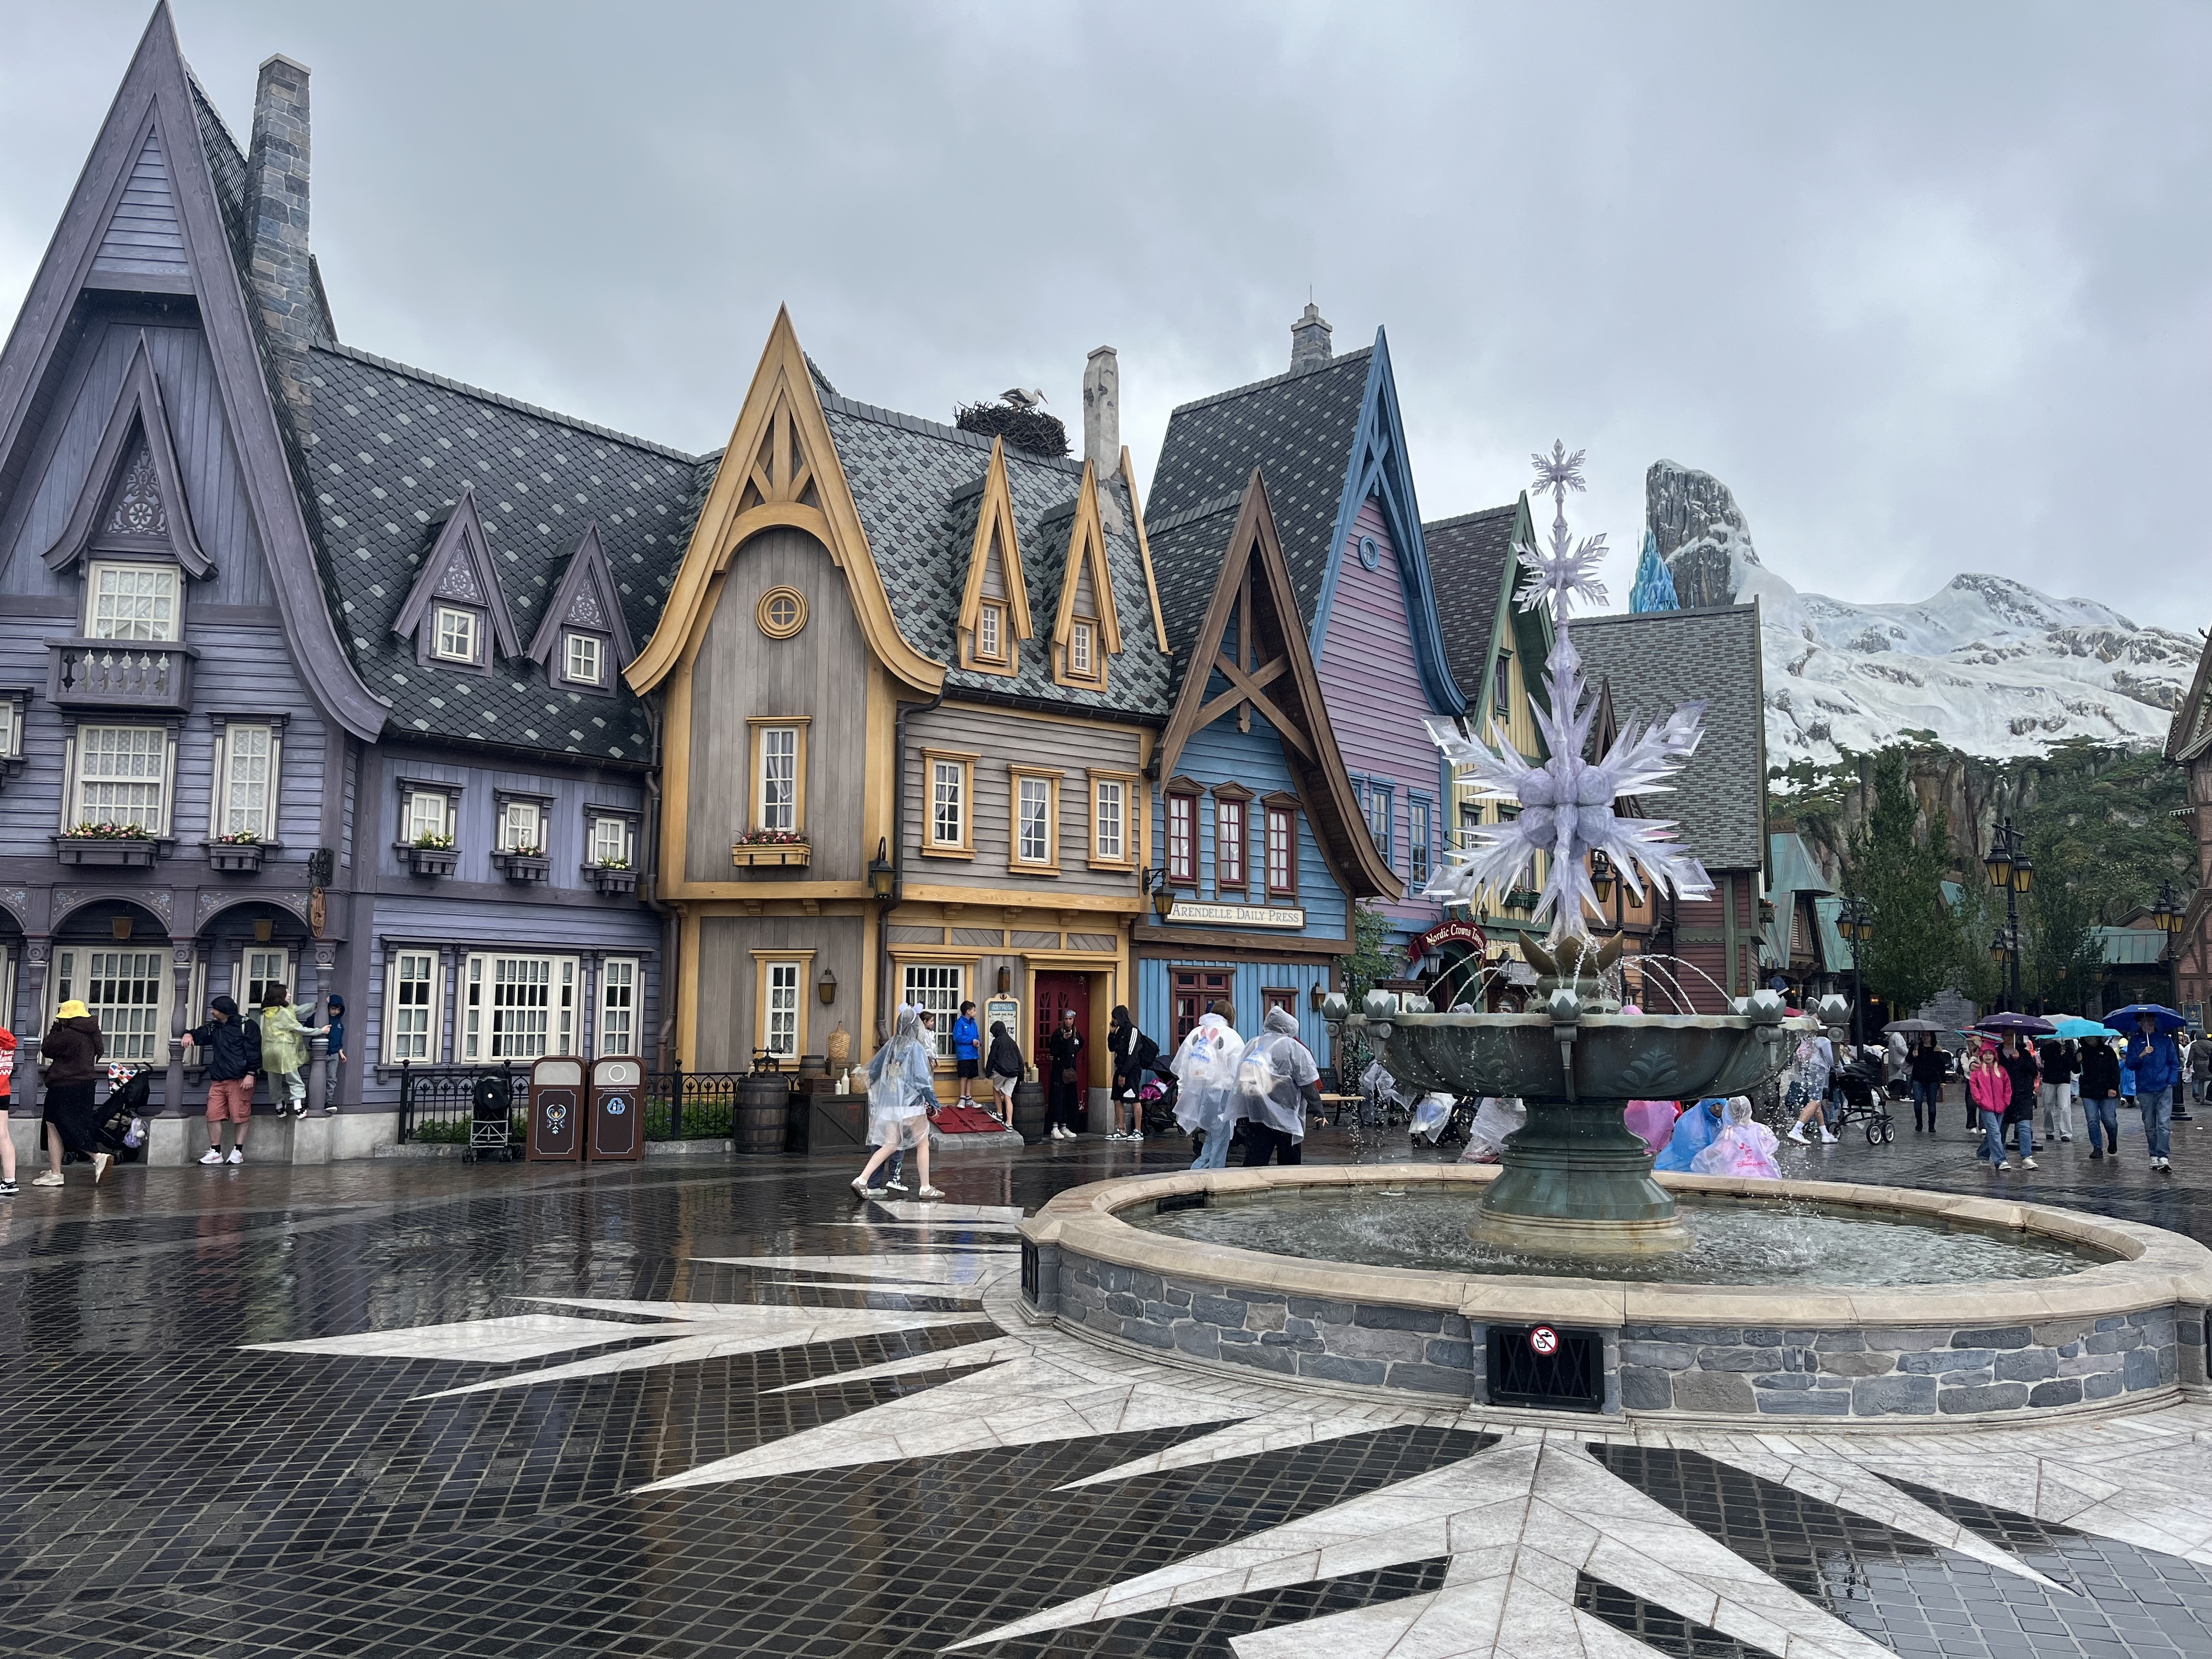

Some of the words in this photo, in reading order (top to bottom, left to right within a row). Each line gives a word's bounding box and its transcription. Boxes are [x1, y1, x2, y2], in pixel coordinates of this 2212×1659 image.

[1172, 904, 1232, 919] ARENDELLE
[1237, 908, 1265, 921] DAILY
[1268, 910, 1299, 922] PRESS
[1425, 927, 1449, 943] Nordic
[1451, 924, 1471, 937] Crowns
